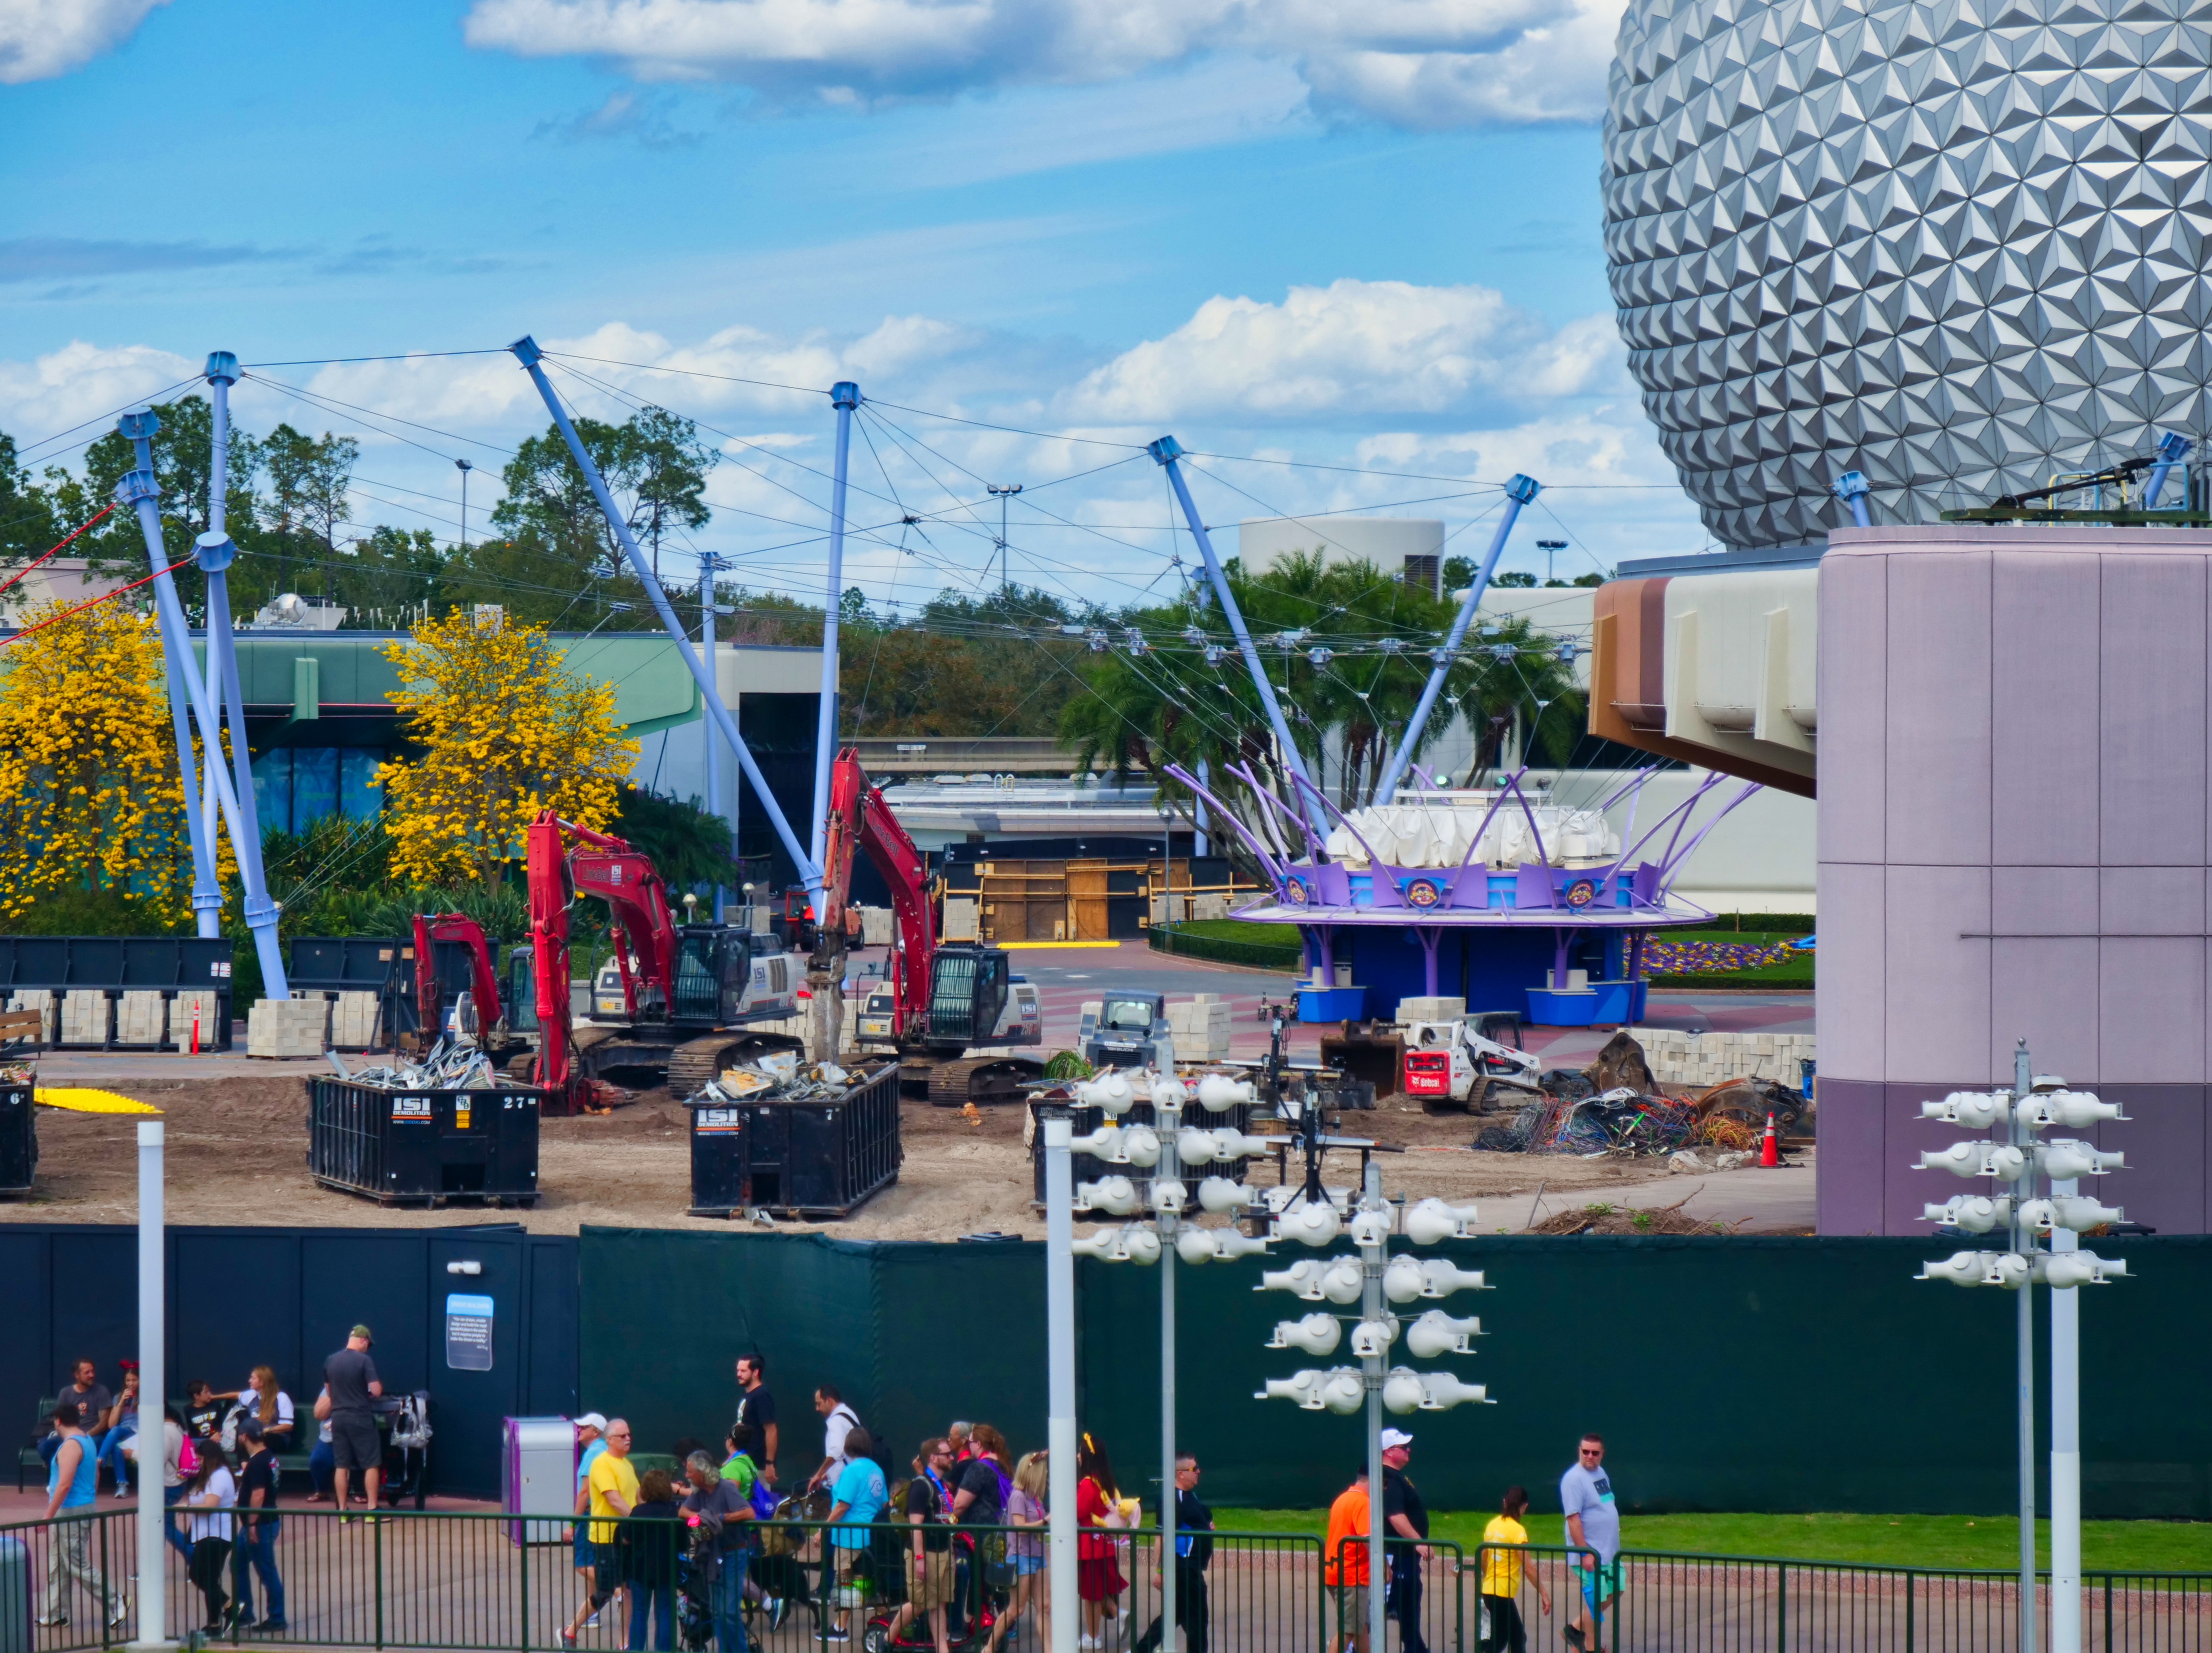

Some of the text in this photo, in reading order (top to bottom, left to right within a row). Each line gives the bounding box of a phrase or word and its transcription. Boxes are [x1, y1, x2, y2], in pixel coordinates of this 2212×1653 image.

[612, 865, 621, 875] ISI
[754, 967, 765, 979] ISI
[1421, 1077, 1440, 1087] Bobcat
[10, 1093, 20, 1104] 6
[1168, 1094, 1173, 1102] A
[393, 1098, 431, 1111] ISI
[698, 1109, 738, 1122] ISI
[826, 1109, 833, 1121] 7
[1120, 1147, 1124, 1155] G
[1987, 1158, 1991, 1166] G
[2094, 1159, 2097, 1167] H
[1948, 1209, 1953, 1217] M
[2044, 1212, 2048, 1220] N
[1365, 1228, 1370, 1237] A
[1994, 1267, 1998, 1275] T
[2095, 1267, 2099, 1275] U
[1314, 1281, 1318, 1290] G
[1427, 1278, 1431, 1286] H
[1364, 1337, 1369, 1345] N
[1314, 1390, 1318, 1398] T
[1426, 1390, 1430, 1398] U
